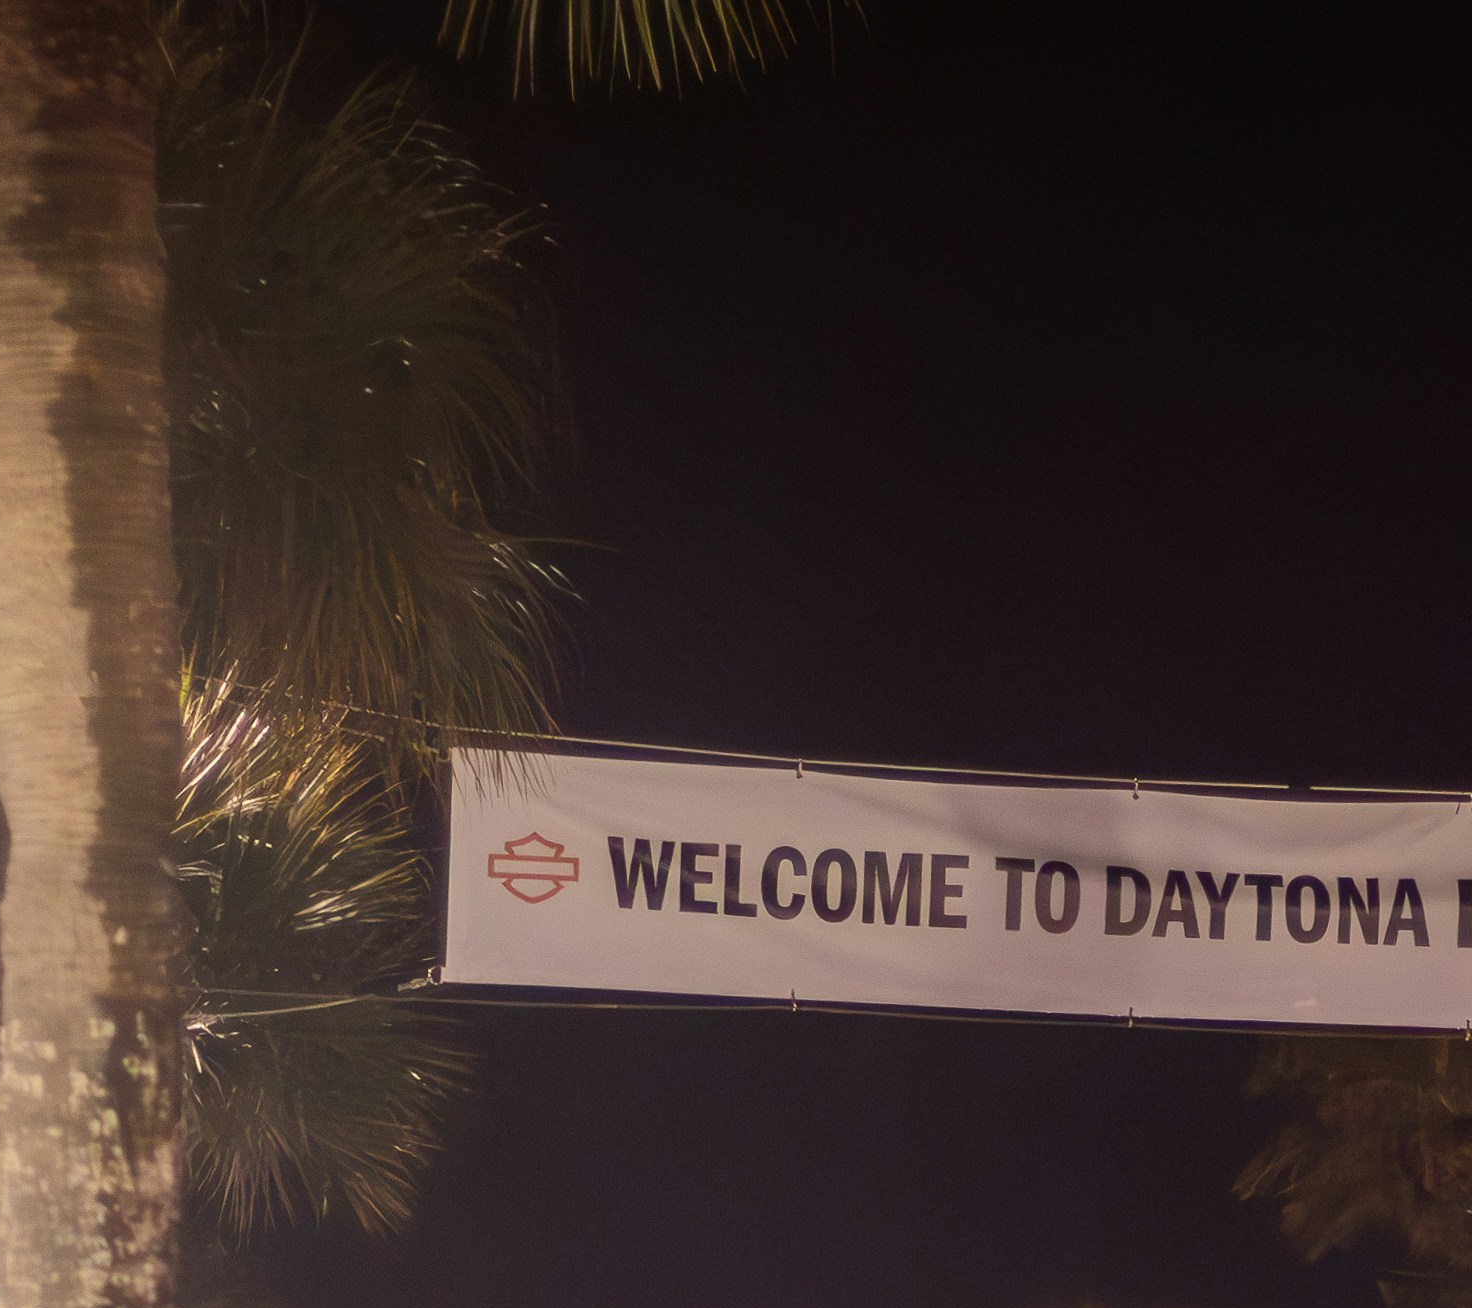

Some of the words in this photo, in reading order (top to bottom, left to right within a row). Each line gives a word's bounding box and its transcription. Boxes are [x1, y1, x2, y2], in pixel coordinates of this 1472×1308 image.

[607, 835, 969, 930] WELCOME
[995, 857, 1081, 934] TO
[1105, 865, 1430, 947] DAYTONA
